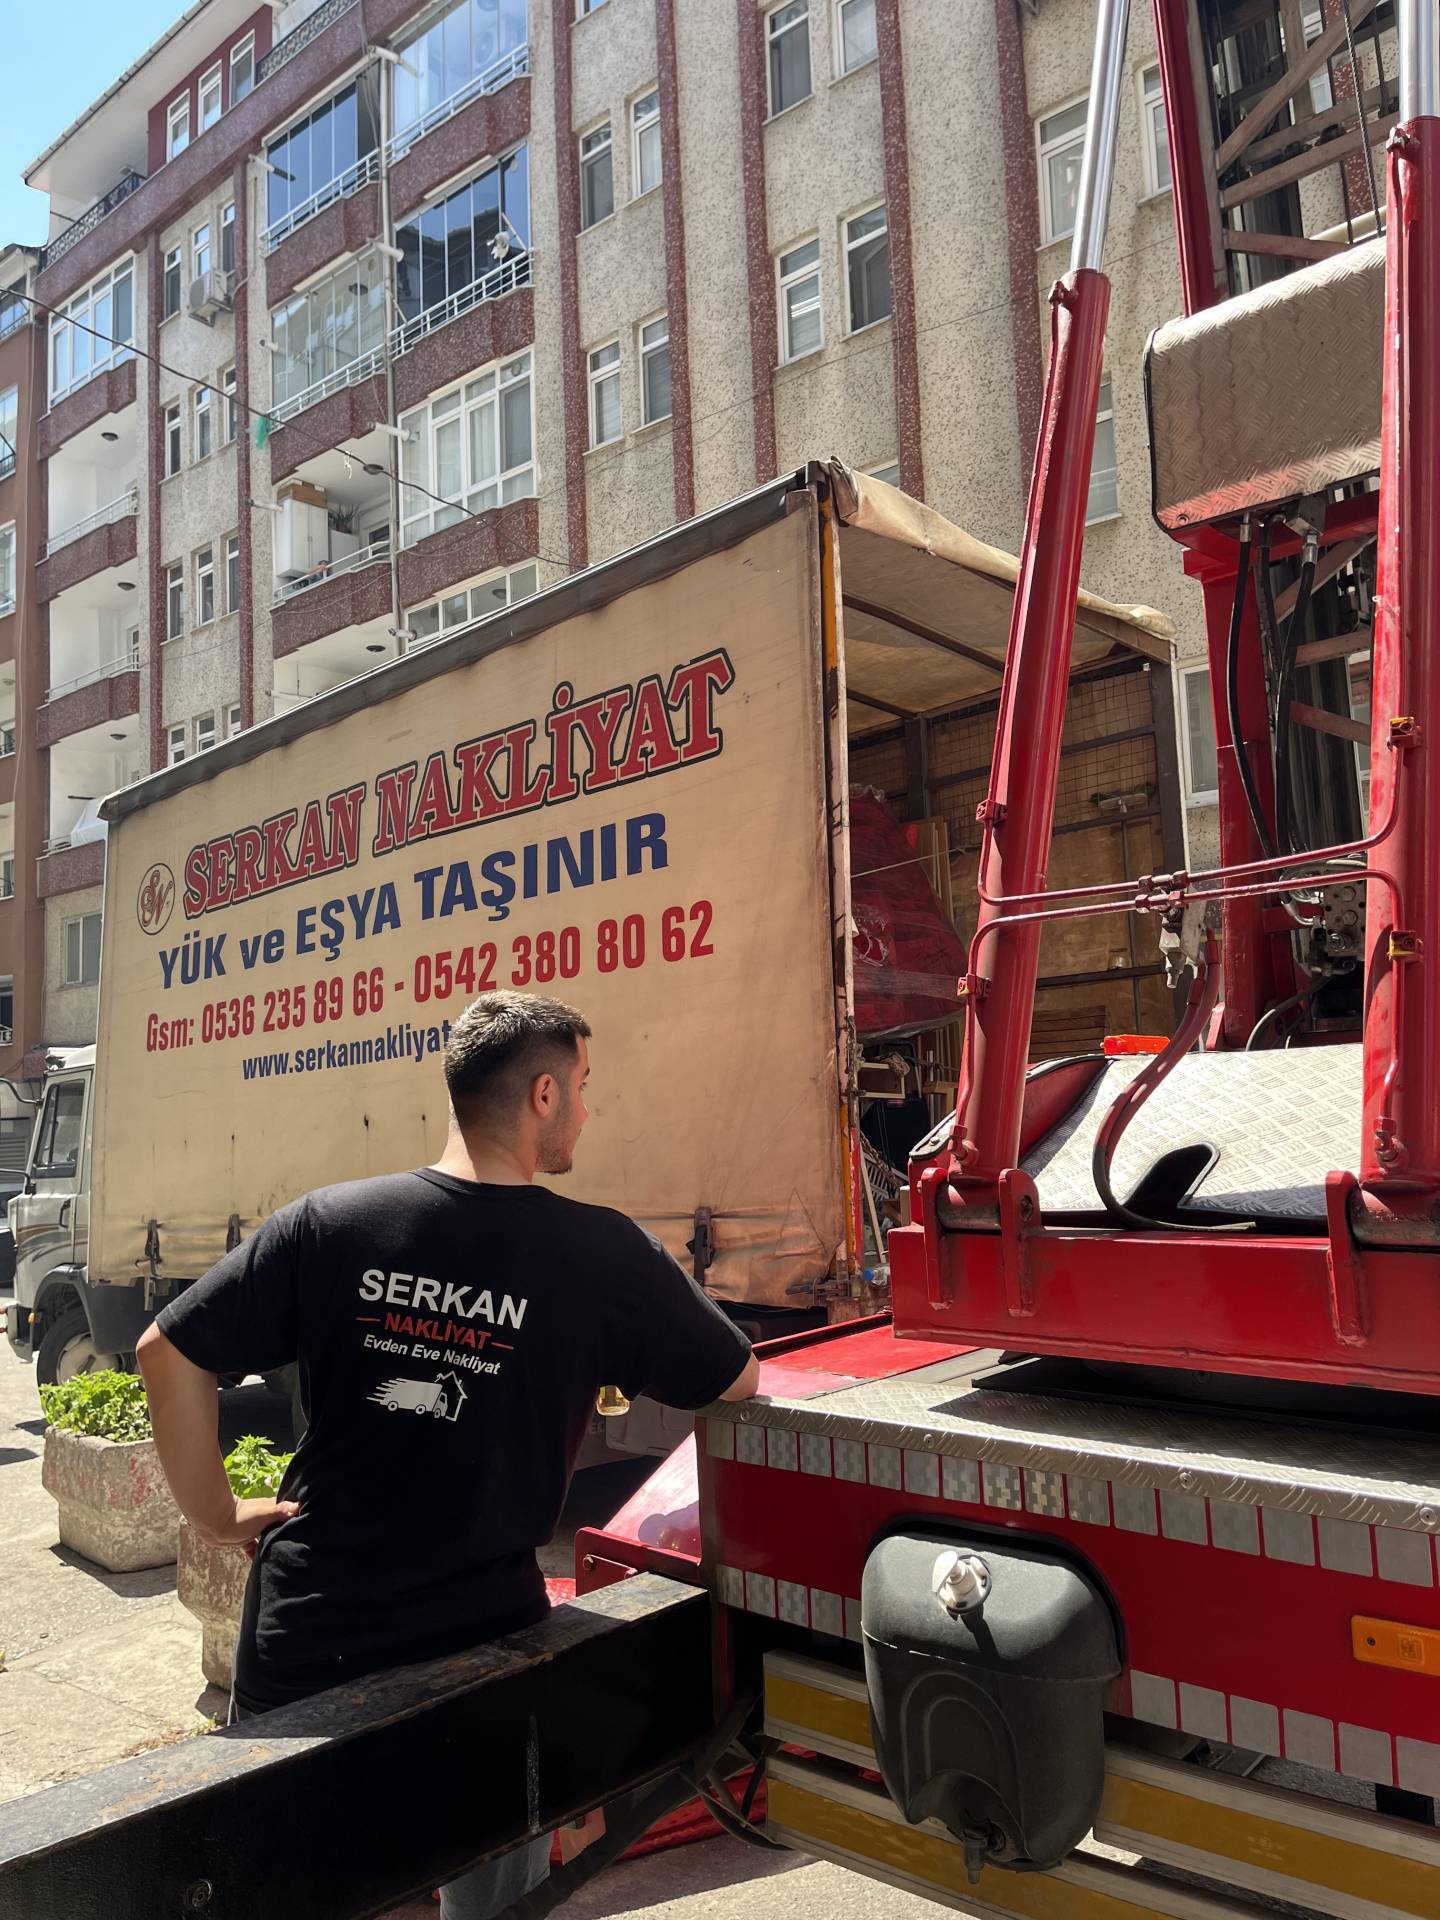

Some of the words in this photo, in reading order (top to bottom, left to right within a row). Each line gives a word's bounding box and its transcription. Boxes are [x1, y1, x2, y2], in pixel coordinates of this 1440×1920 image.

[183, 783, 366, 919] SERKAN
[373, 648, 735, 858] NAKLİYAT
[159, 931, 226, 989] YÜK
[240, 929, 285, 969] ve
[297, 882, 401, 961] EŞYA
[414, 813, 669, 921] TAŞINIR
[147, 1014, 194, 1051] Gsm:
[202, 995, 255, 1043] 0536
[263, 985, 305, 1032] 235
[313, 977, 343, 1023] 89
[353, 967, 384, 1016] 66
[414, 942, 497, 1002] 0542
[512, 927, 580, 985] 380
[597, 914, 645, 973] 80
[662, 900, 714, 962] 62
[359, 1269, 528, 1329] SERKAN
[384, 1312, 491, 1350] NAKLİYAT
[364, 1334, 408, 1355] Evden
[412, 1344, 440, 1360] Eve
[443, 1349, 501, 1375] Nakliyat
